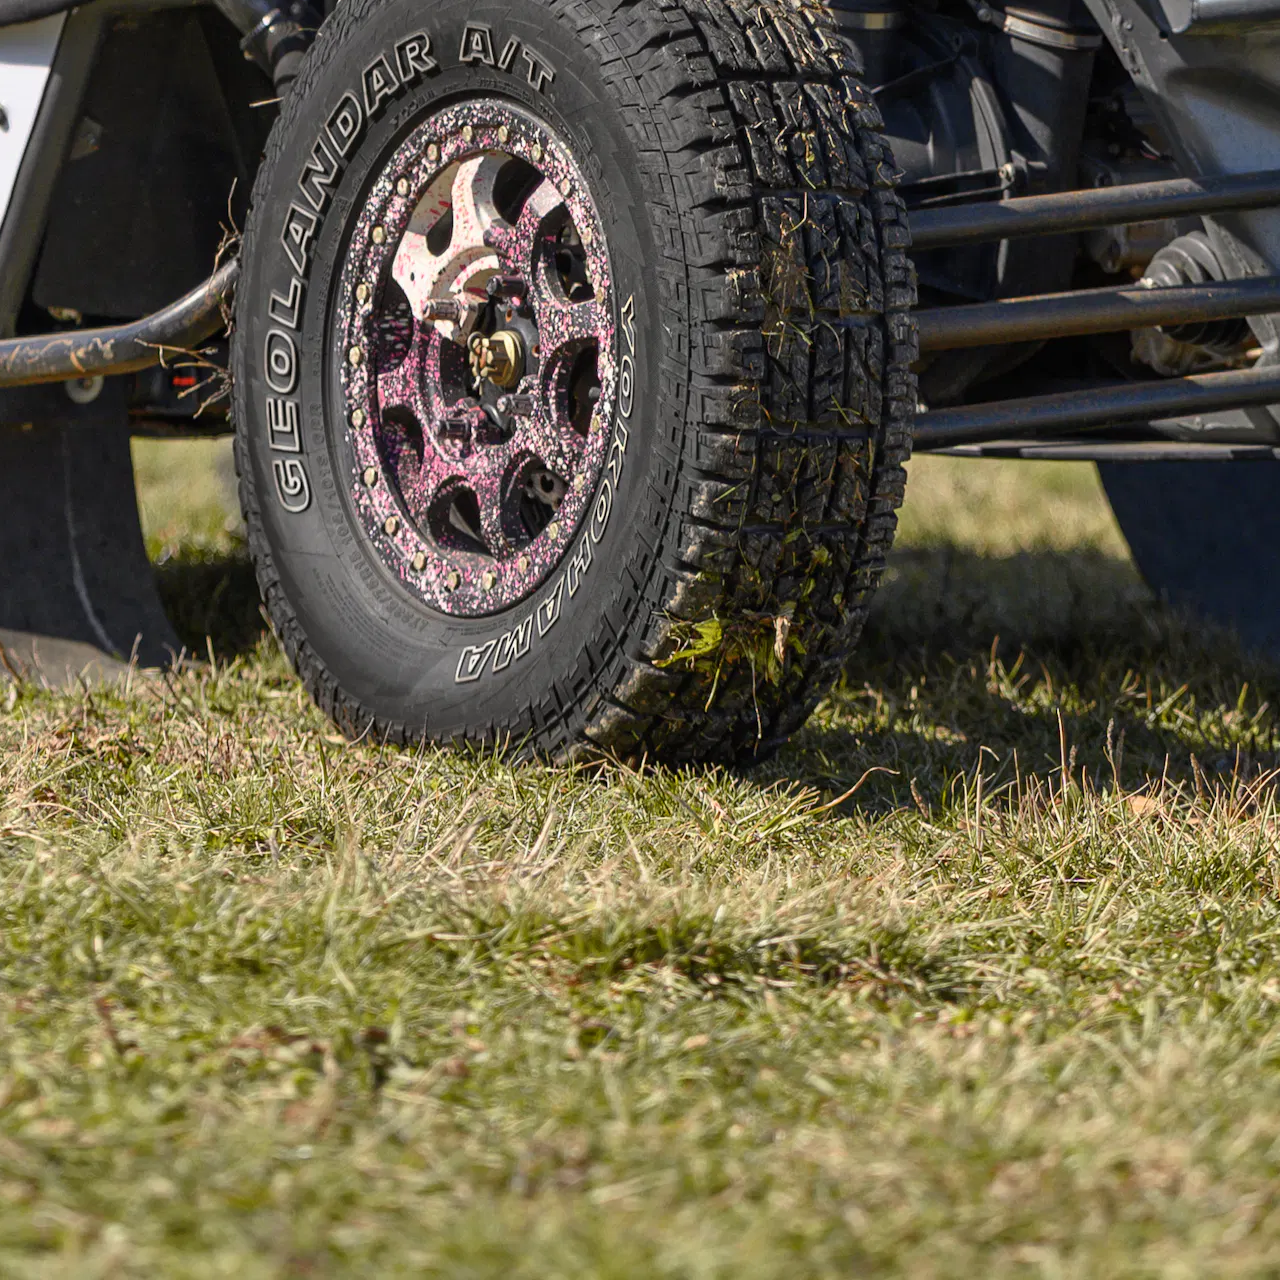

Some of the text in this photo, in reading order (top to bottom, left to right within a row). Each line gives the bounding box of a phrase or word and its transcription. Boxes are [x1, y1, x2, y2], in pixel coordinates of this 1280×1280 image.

[264, 31, 437, 515] GEOLANDAR
[460, 22, 557, 92] A/T
[454, 293, 637, 686] YOKOHAMA
